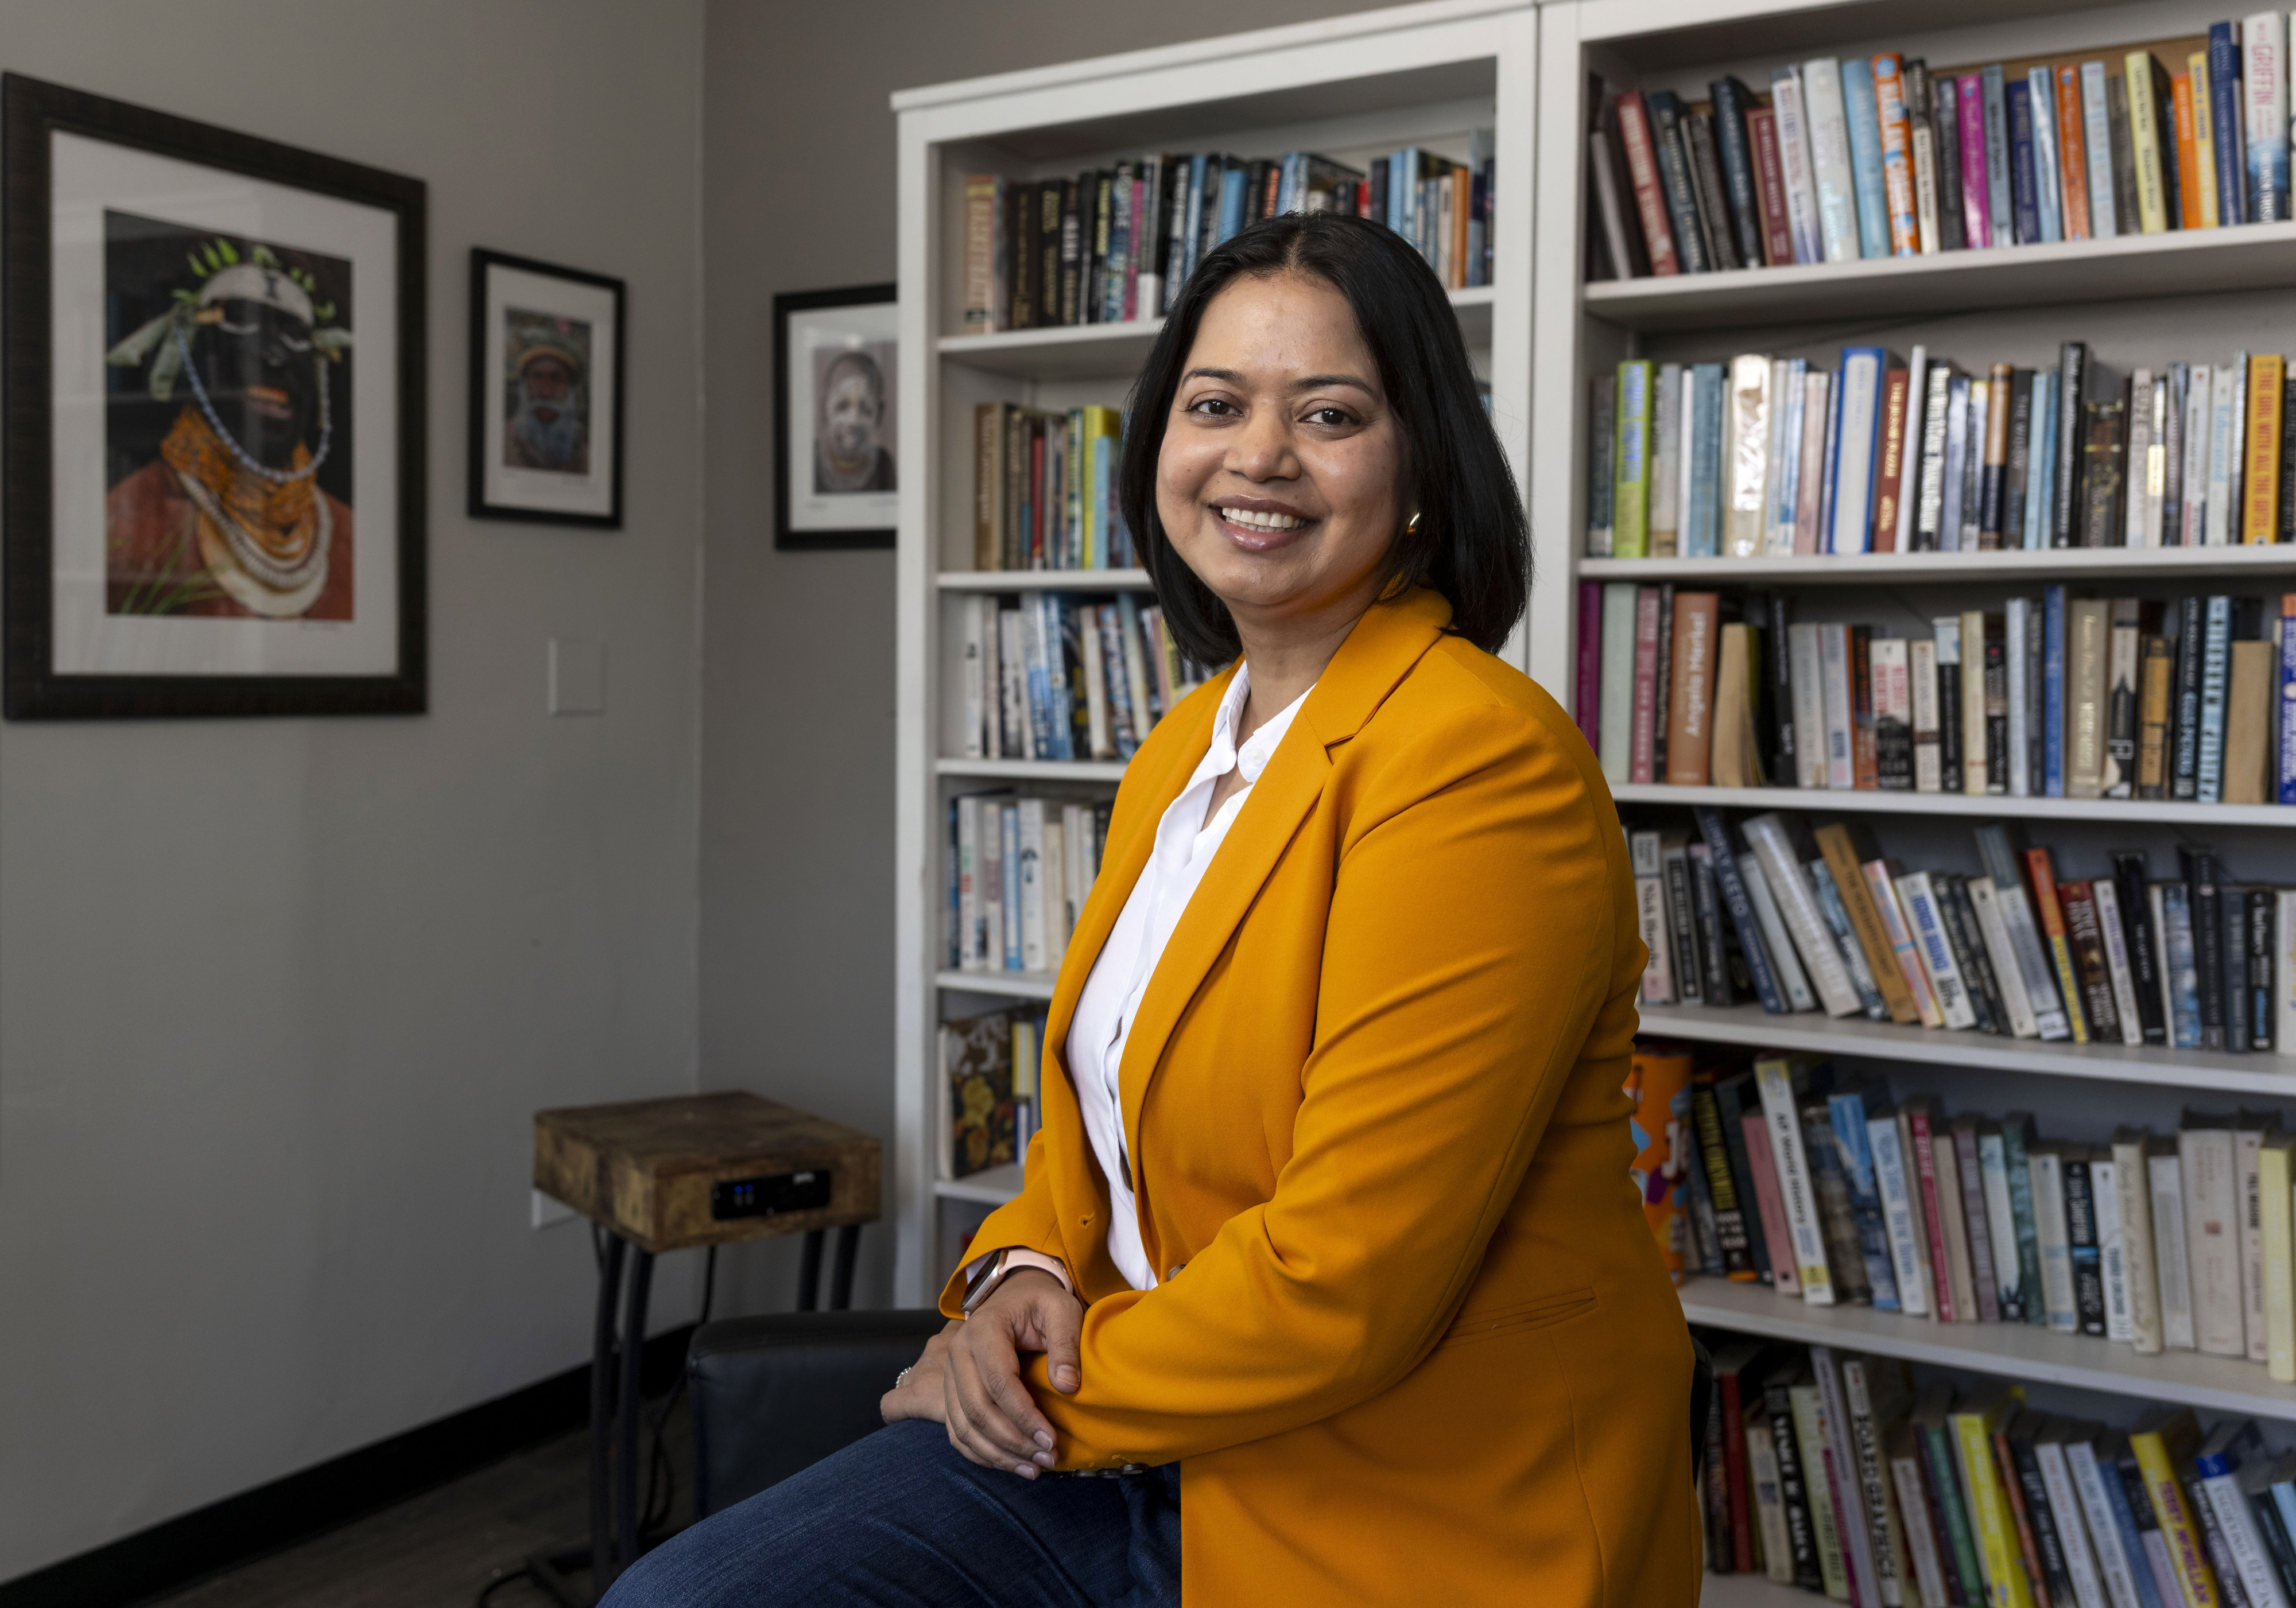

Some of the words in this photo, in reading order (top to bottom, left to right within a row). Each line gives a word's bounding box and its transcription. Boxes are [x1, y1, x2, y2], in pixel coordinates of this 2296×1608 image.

[2251, 44, 2275, 106] GRIFFIN
[1879, 83, 1906, 151] HARLAN
[1761, 134, 1775, 179] INTELLIGENT
[2258, 371, 2275, 391] THE
[2257, 393, 2274, 418] GIRL
[2256, 423, 2274, 450] WITH
[2256, 453, 2272, 472] ALL
[2254, 476, 2272, 495] THE
[2253, 498, 2271, 529] GIFTS
[1688, 612, 1707, 673] Merkel
[1685, 674, 1705, 737] Angela
[1706, 817, 1736, 867] SIMPLY
[1723, 872, 1749, 917] KETO
[1776, 1113, 1791, 1132] AP
[1780, 1136, 1799, 1176] World
[1789, 1178, 1808, 1224] History
